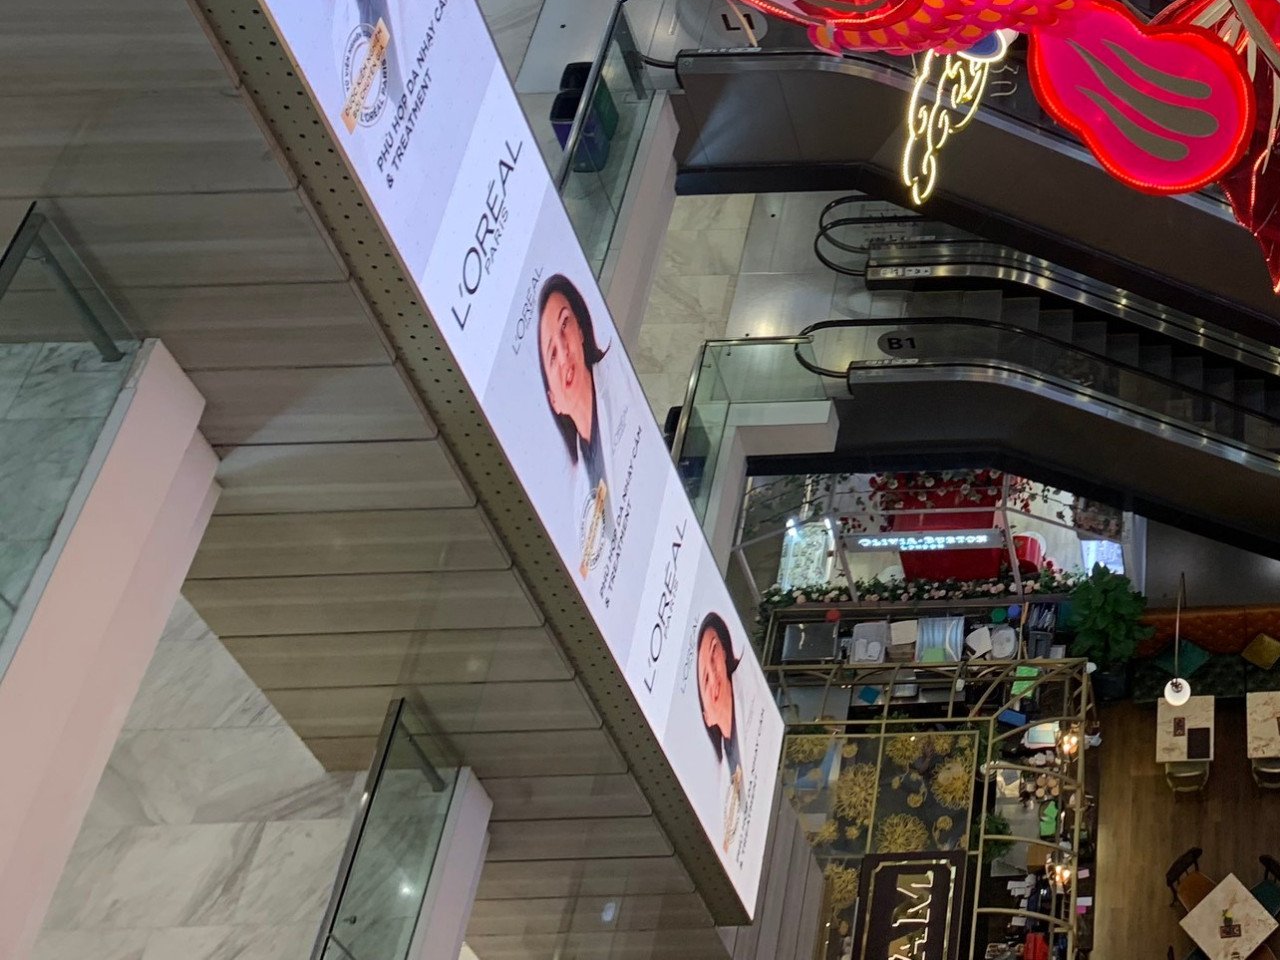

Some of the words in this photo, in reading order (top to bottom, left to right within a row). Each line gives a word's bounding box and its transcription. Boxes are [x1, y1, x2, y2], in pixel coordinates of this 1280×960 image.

[720, 10, 756, 33] L1
[377, 131, 394, 173] PHÙ
[406, 70, 420, 96] DA
[386, 173, 395, 189] &
[391, 67, 433, 171] TREATMENT
[451, 140, 523, 331] L'ORÉAL
[484, 206, 509, 275] PARIS
[887, 336, 916, 350] B1
